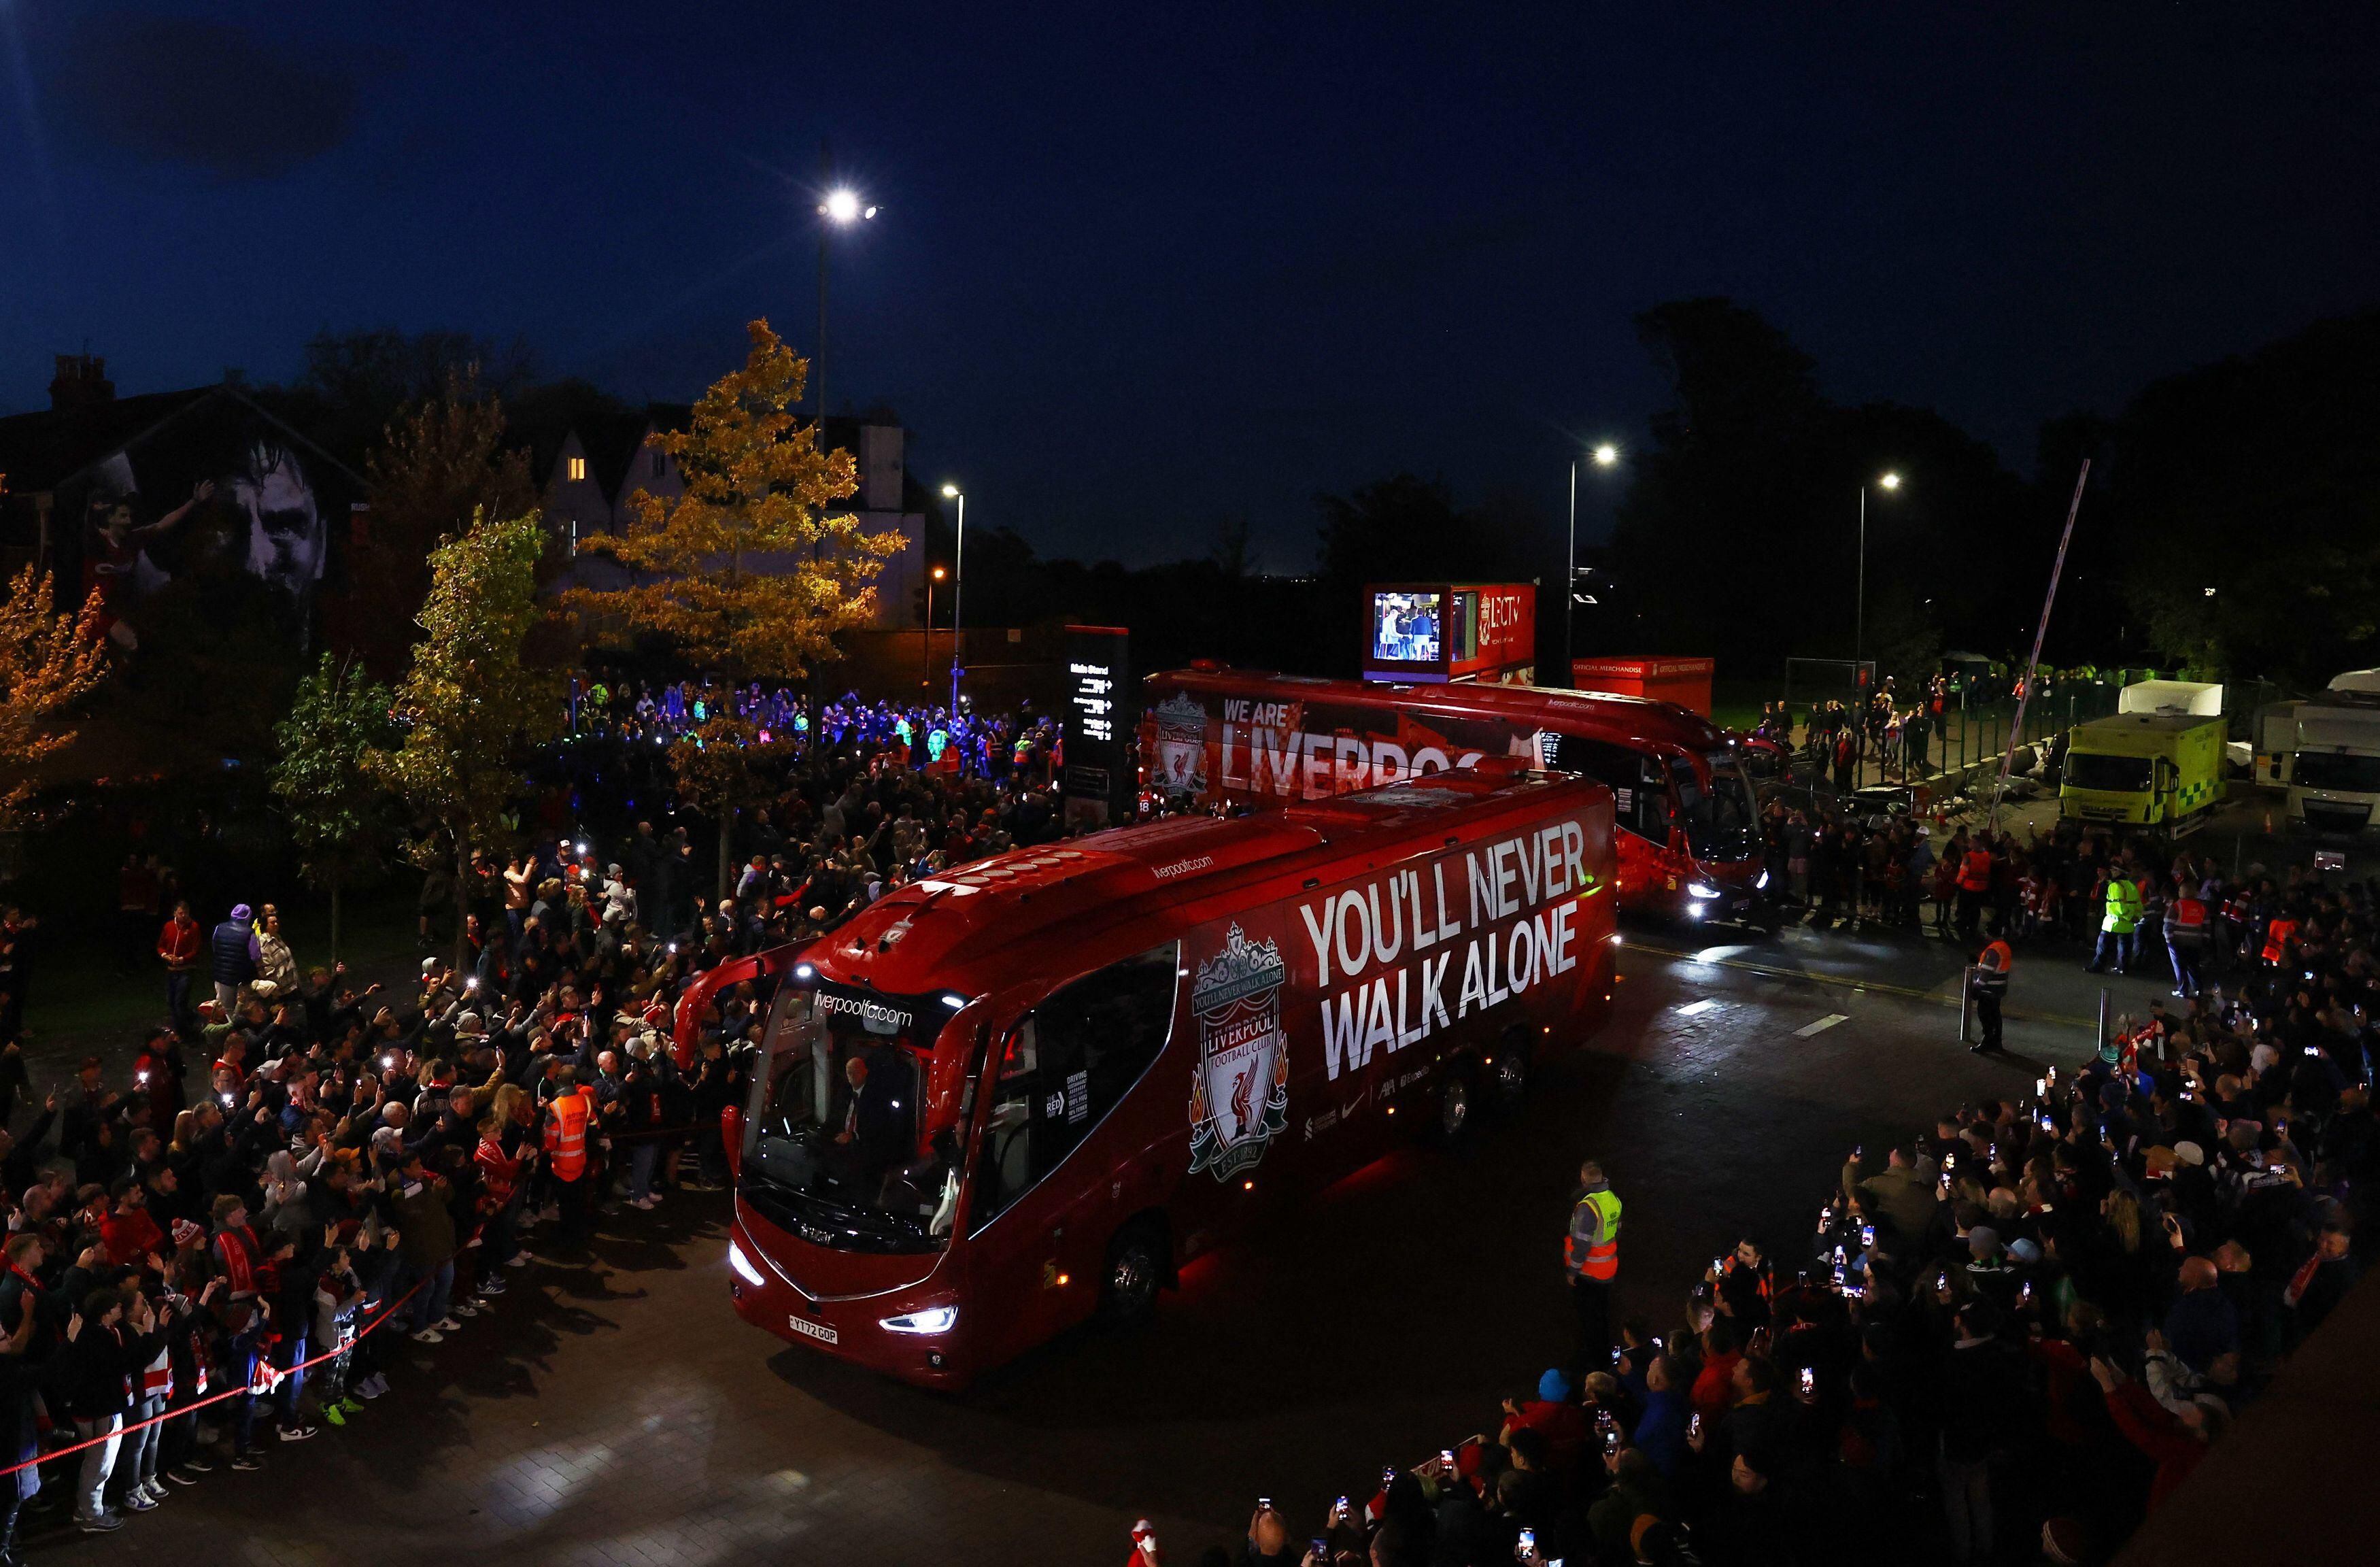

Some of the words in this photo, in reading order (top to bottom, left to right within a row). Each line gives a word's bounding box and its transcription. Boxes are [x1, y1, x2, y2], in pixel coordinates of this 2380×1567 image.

[1599, 665, 1642, 673] MERCHANDISE
[1224, 698, 1251, 723] WE
[1251, 702, 1289, 728] ARE
[1140, 802, 1149, 813] 18
[1151, 856, 1214, 879] liverpoolfc.com
[1299, 863, 1461, 988] YOU'LL
[1466, 820, 1586, 929] NEVER
[1219, 984, 1240, 1002] NEVER
[1241, 977, 1260, 994] WALK
[1261, 968, 1282, 988] ALONE
[1321, 950, 1451, 1081] WALK
[1458, 900, 1578, 1020] ALONE
[814, 989, 913, 1027] liverpoolfc.com
[1208, 1011, 1273, 1054] LIVERPOOL
[1210, 1044, 1250, 1069] FOOTBALL
[1252, 1036, 1271, 1052] CLUB
[1067, 1070, 1087, 1084] DRIVING
[1047, 1099, 1061, 1113] RED
[794, 1319, 817, 1336] YT72
[818, 1328, 836, 1341] GOP
